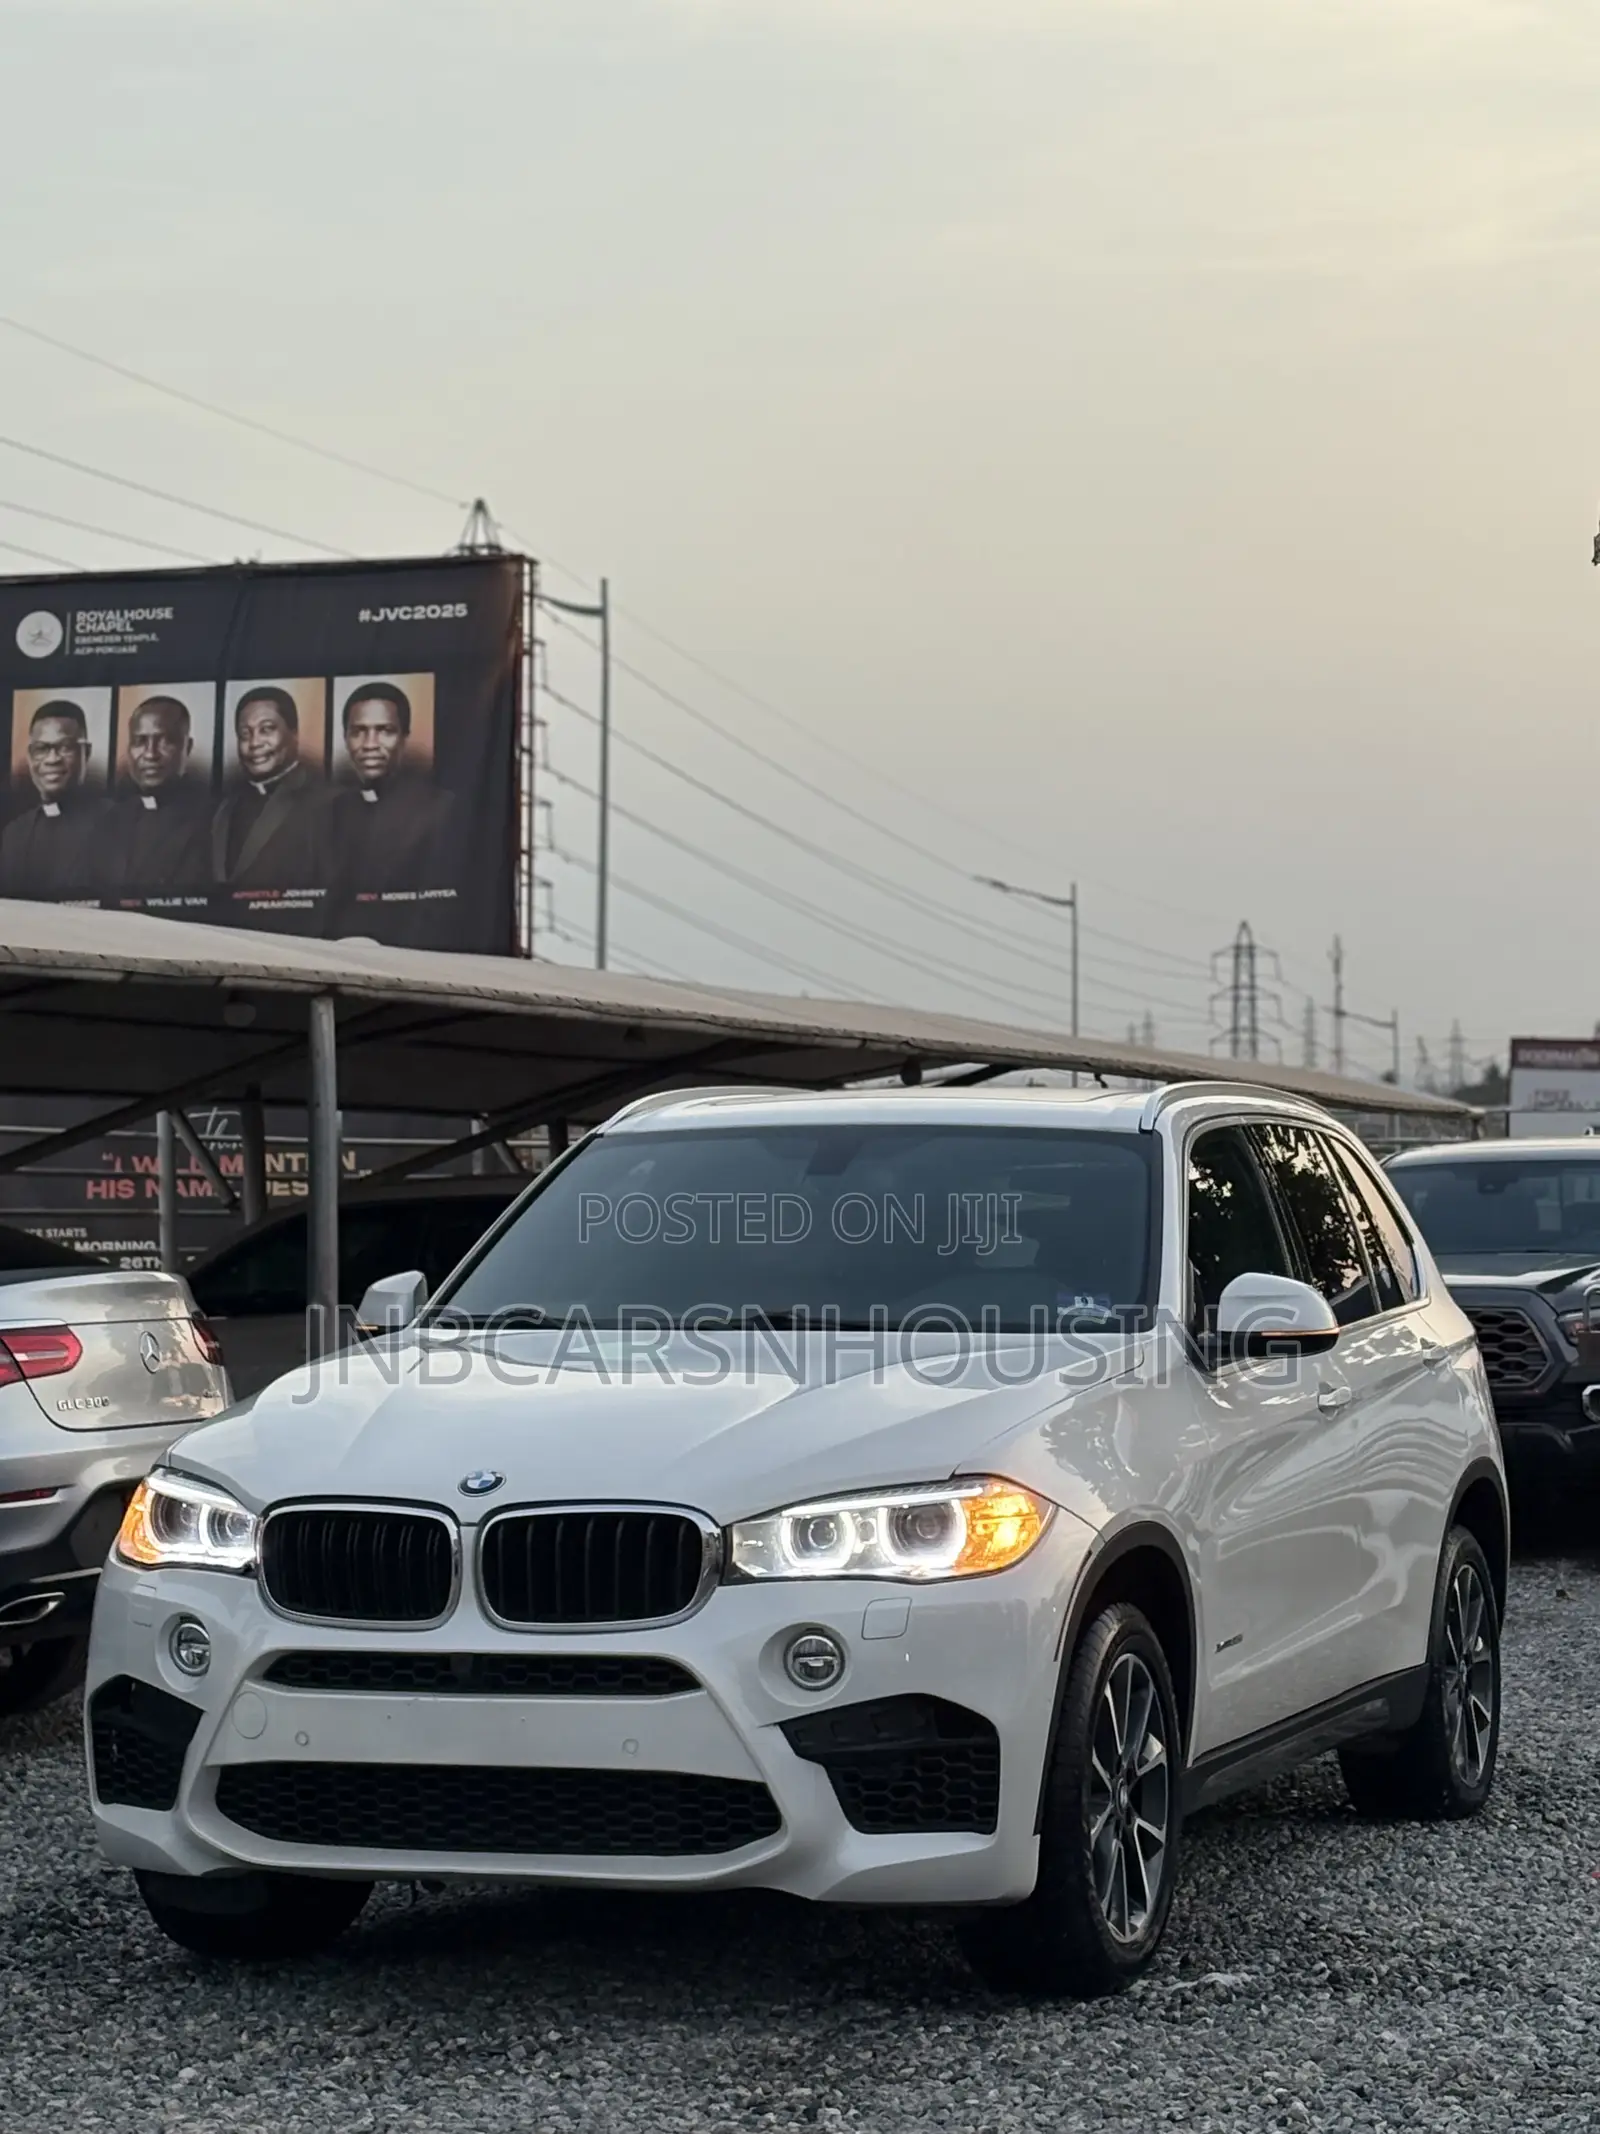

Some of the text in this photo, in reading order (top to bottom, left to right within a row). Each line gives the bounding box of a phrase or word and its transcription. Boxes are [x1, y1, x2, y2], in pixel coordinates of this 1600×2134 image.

[76, 606, 174, 622] ROYALHOUSE
[358, 603, 468, 622] #JVC2025
[75, 620, 134, 633] CHAPEL
[86, 1178, 135, 1200] HIS
[45, 1227, 88, 1239] STARTS
[56, 1397, 85, 1412] GLC
